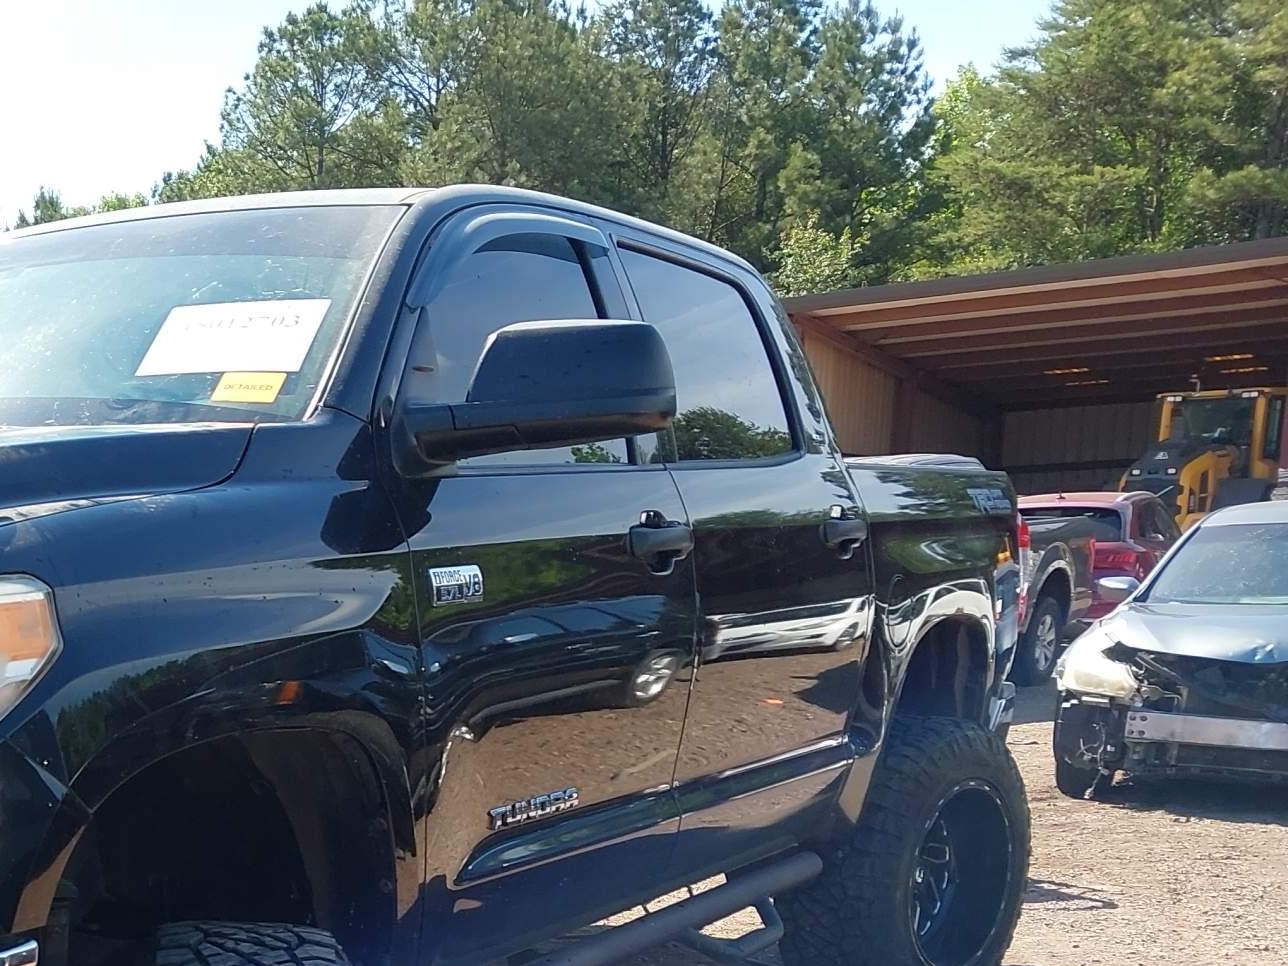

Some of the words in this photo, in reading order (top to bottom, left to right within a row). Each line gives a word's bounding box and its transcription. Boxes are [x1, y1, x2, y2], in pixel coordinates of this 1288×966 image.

[183, 313, 302, 330] 5012703
[463, 573, 482, 597] V8
[488, 787, 579, 830] TUNDRA
